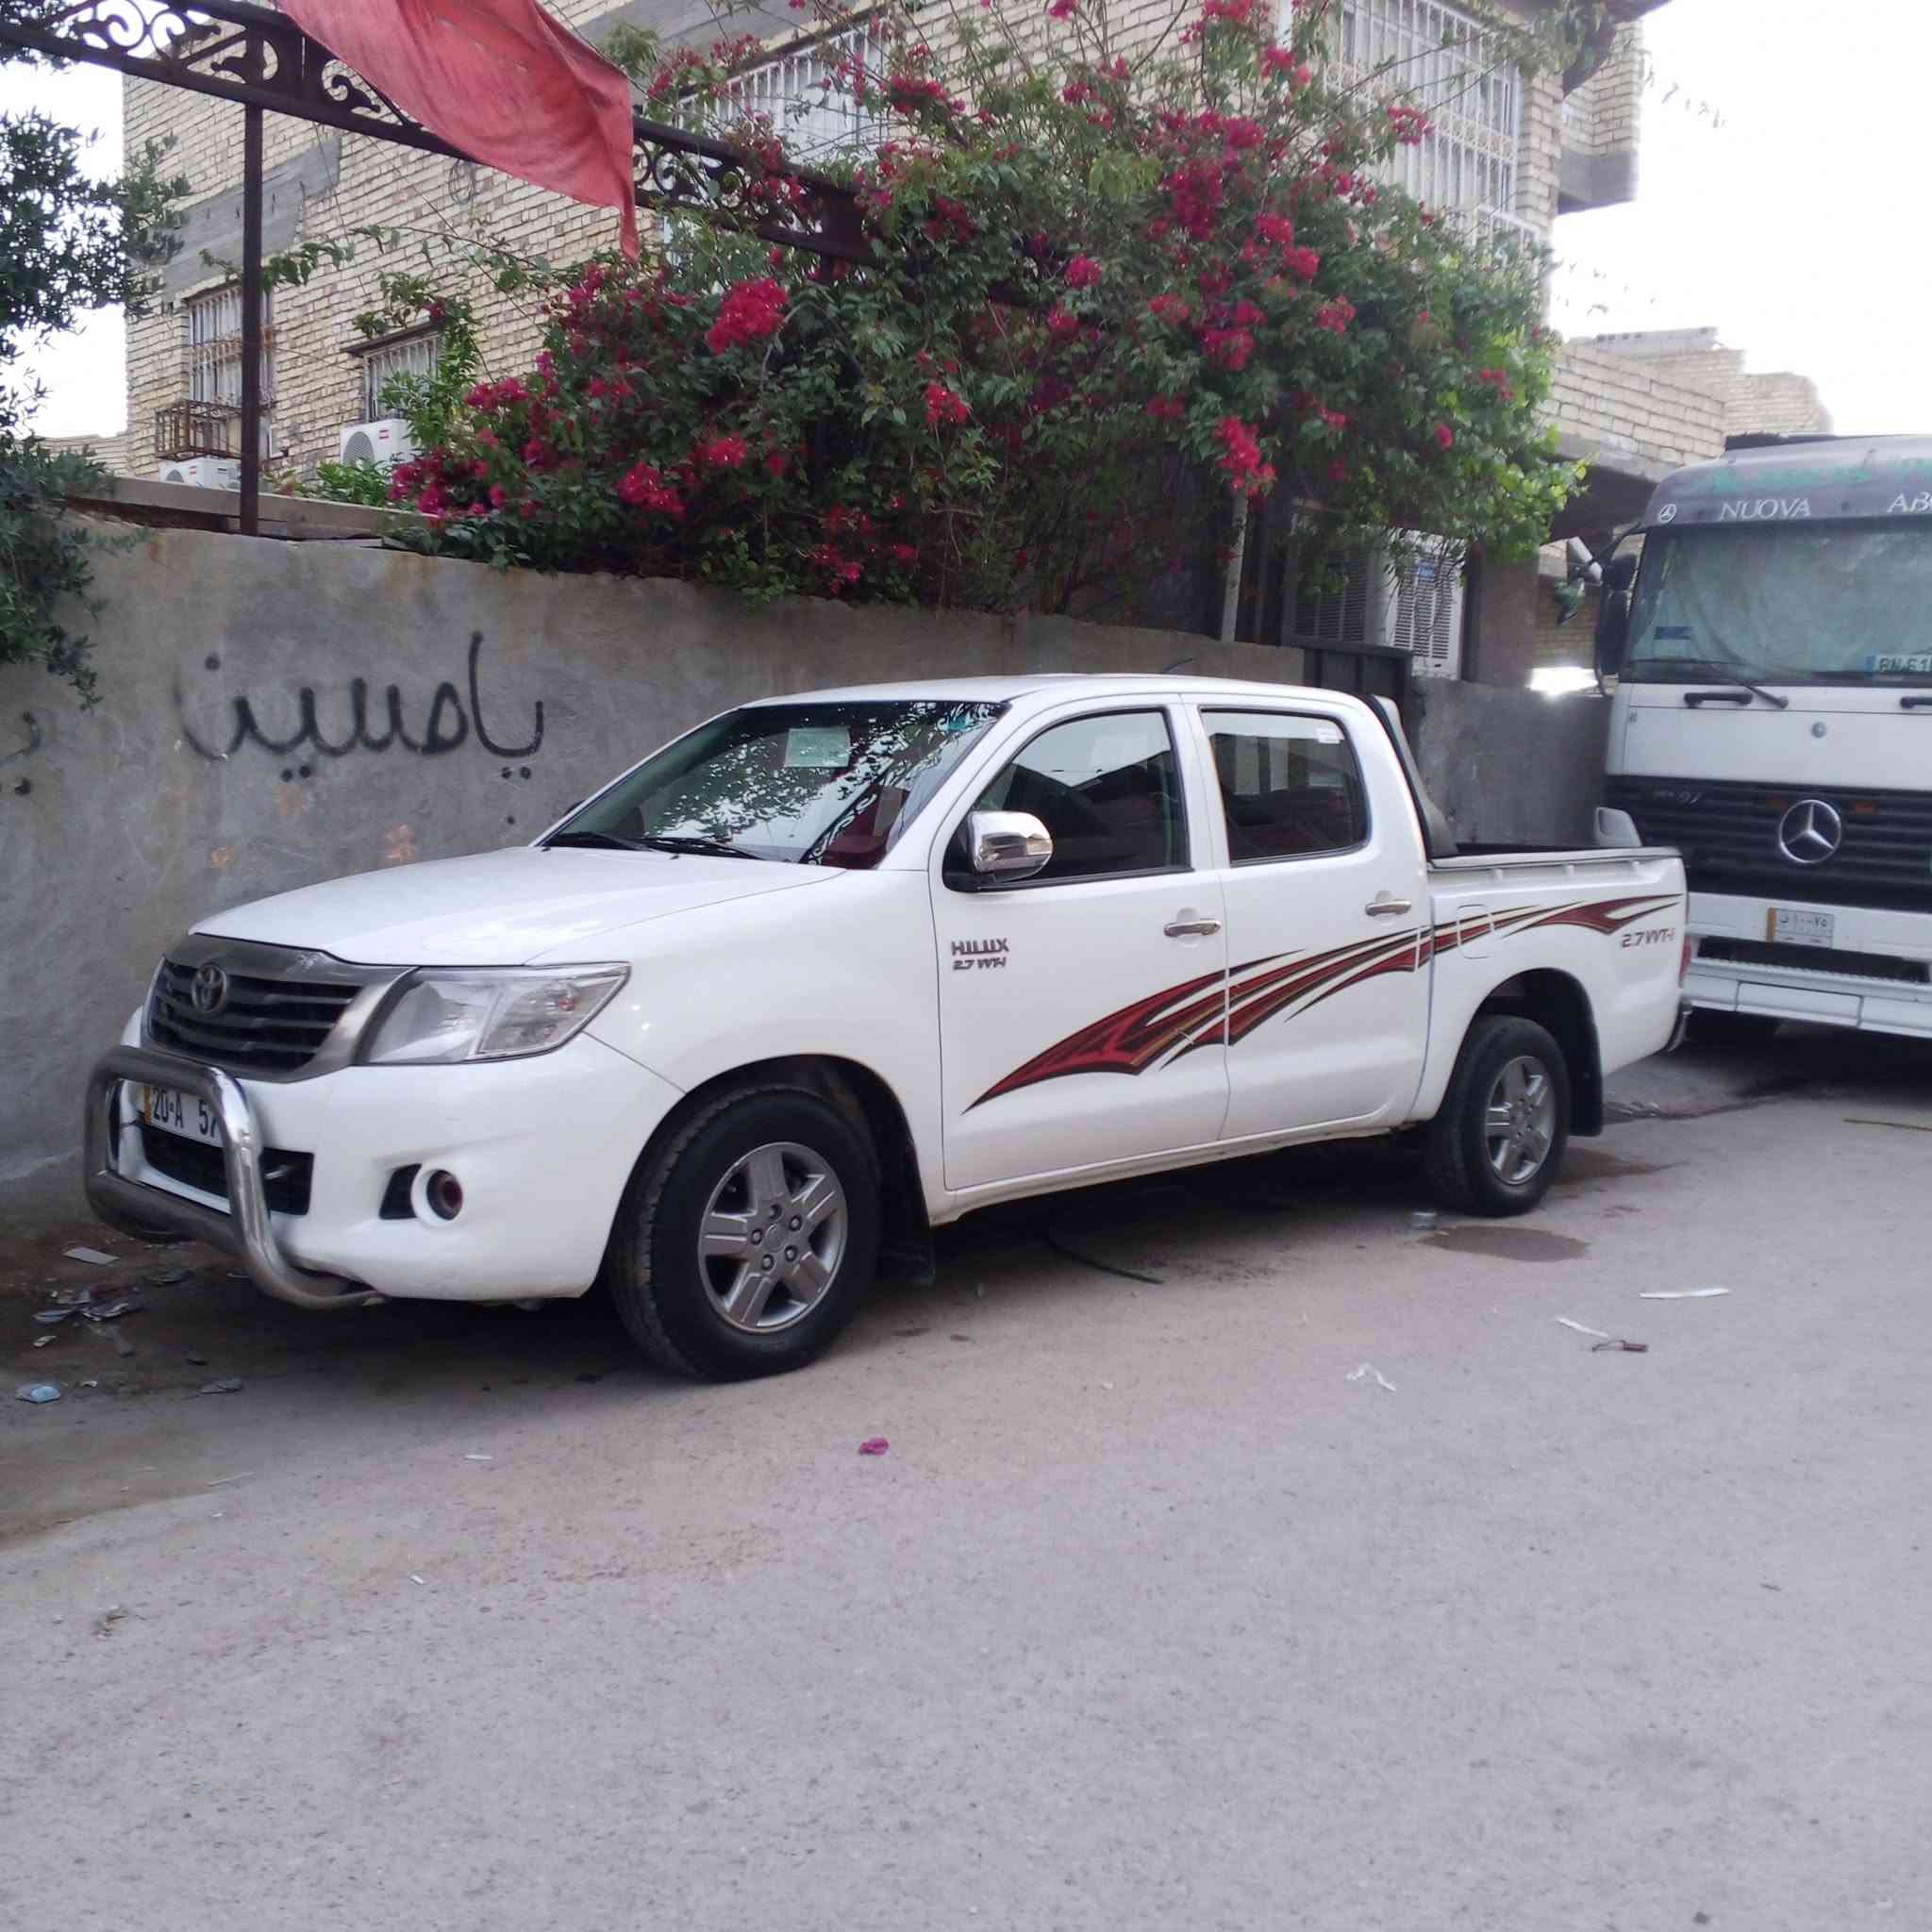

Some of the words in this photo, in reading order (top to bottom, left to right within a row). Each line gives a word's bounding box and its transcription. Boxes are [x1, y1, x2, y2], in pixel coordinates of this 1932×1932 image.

[1719, 497, 1812, 522] NUOVA
[1886, 490, 1932, 514] AB
[951, 937, 1009, 957] HILUX
